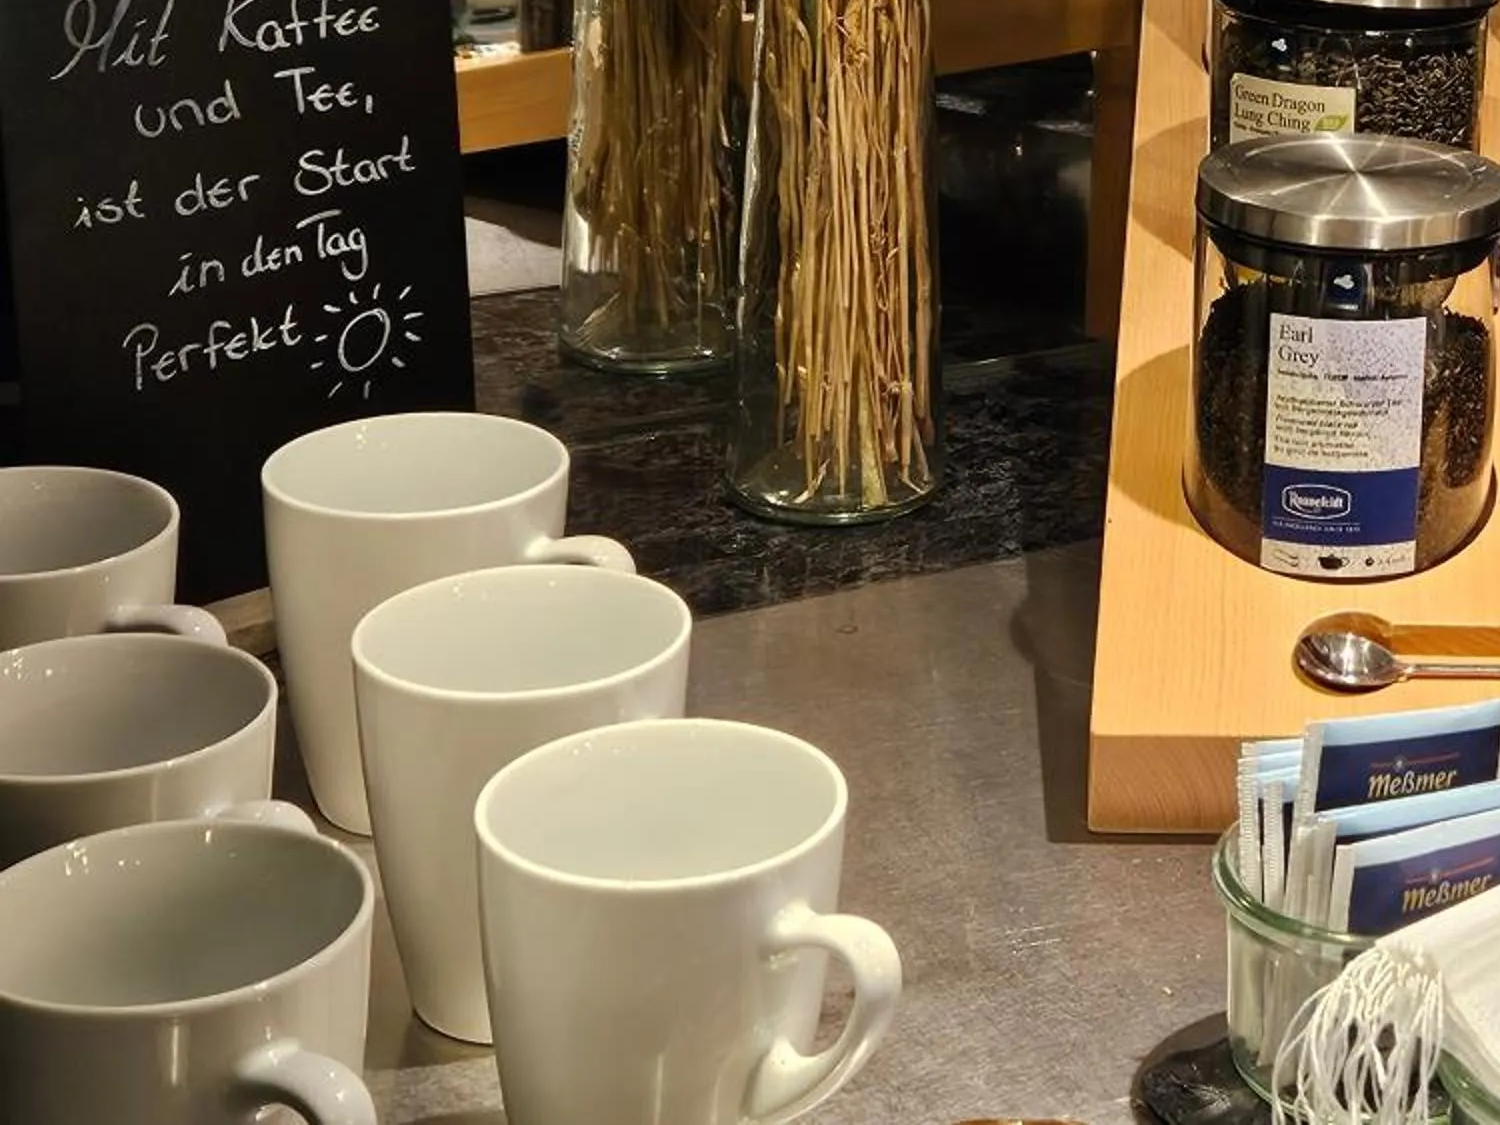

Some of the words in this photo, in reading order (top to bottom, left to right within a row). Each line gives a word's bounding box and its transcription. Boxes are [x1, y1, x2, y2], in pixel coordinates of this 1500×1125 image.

[134, 80, 241, 138] und
[274, 66, 374, 115] Tee,
[1234, 83, 1269, 106] Green
[1271, 92, 1326, 116] Dragon
[1234, 102, 1264, 128] Lung
[1267, 110, 1311, 134] Ching
[73, 179, 147, 229] ist
[175, 172, 261, 217] der
[294, 135, 418, 196] Start
[168, 254, 226, 296] in
[241, 234, 303, 278] den
[296, 209, 370, 281] Tag
[123, 303, 303, 391] Perfekt
[1277, 323, 1314, 345] Earl
[1277, 345, 1320, 367] Grey
[1367, 769, 1458, 799] Meßmer
[1402, 874, 1492, 914] Meßmer
